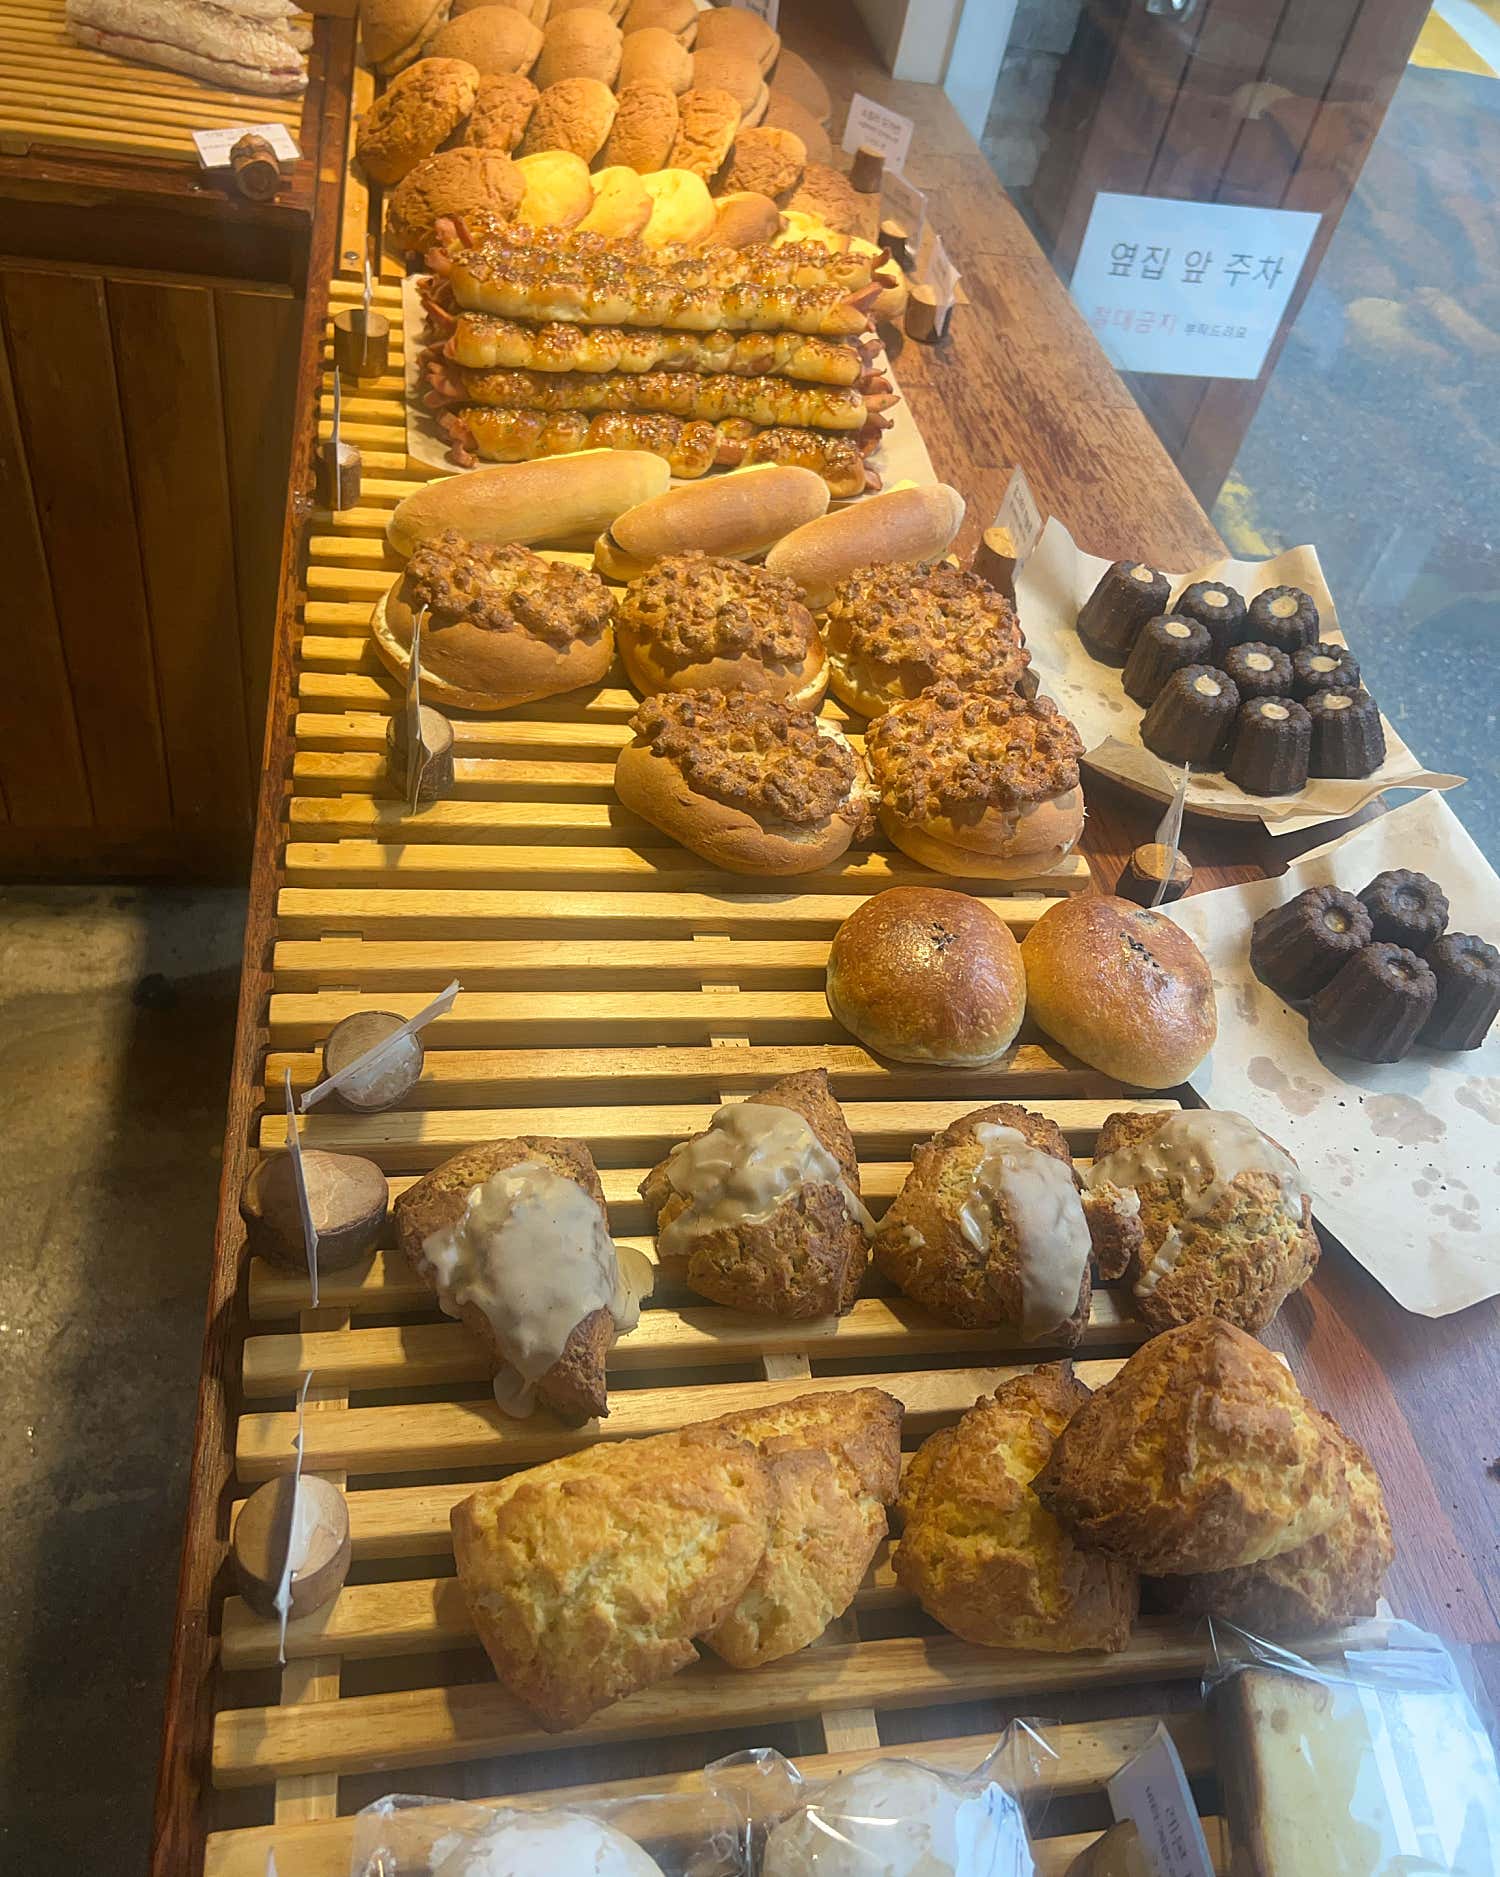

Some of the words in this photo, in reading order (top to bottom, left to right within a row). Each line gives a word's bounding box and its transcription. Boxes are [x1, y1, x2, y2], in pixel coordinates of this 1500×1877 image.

[1108, 242, 1170, 280] 옆집
[1181, 250, 1213, 284] 앞
[1223, 254, 1284, 289] 주차
